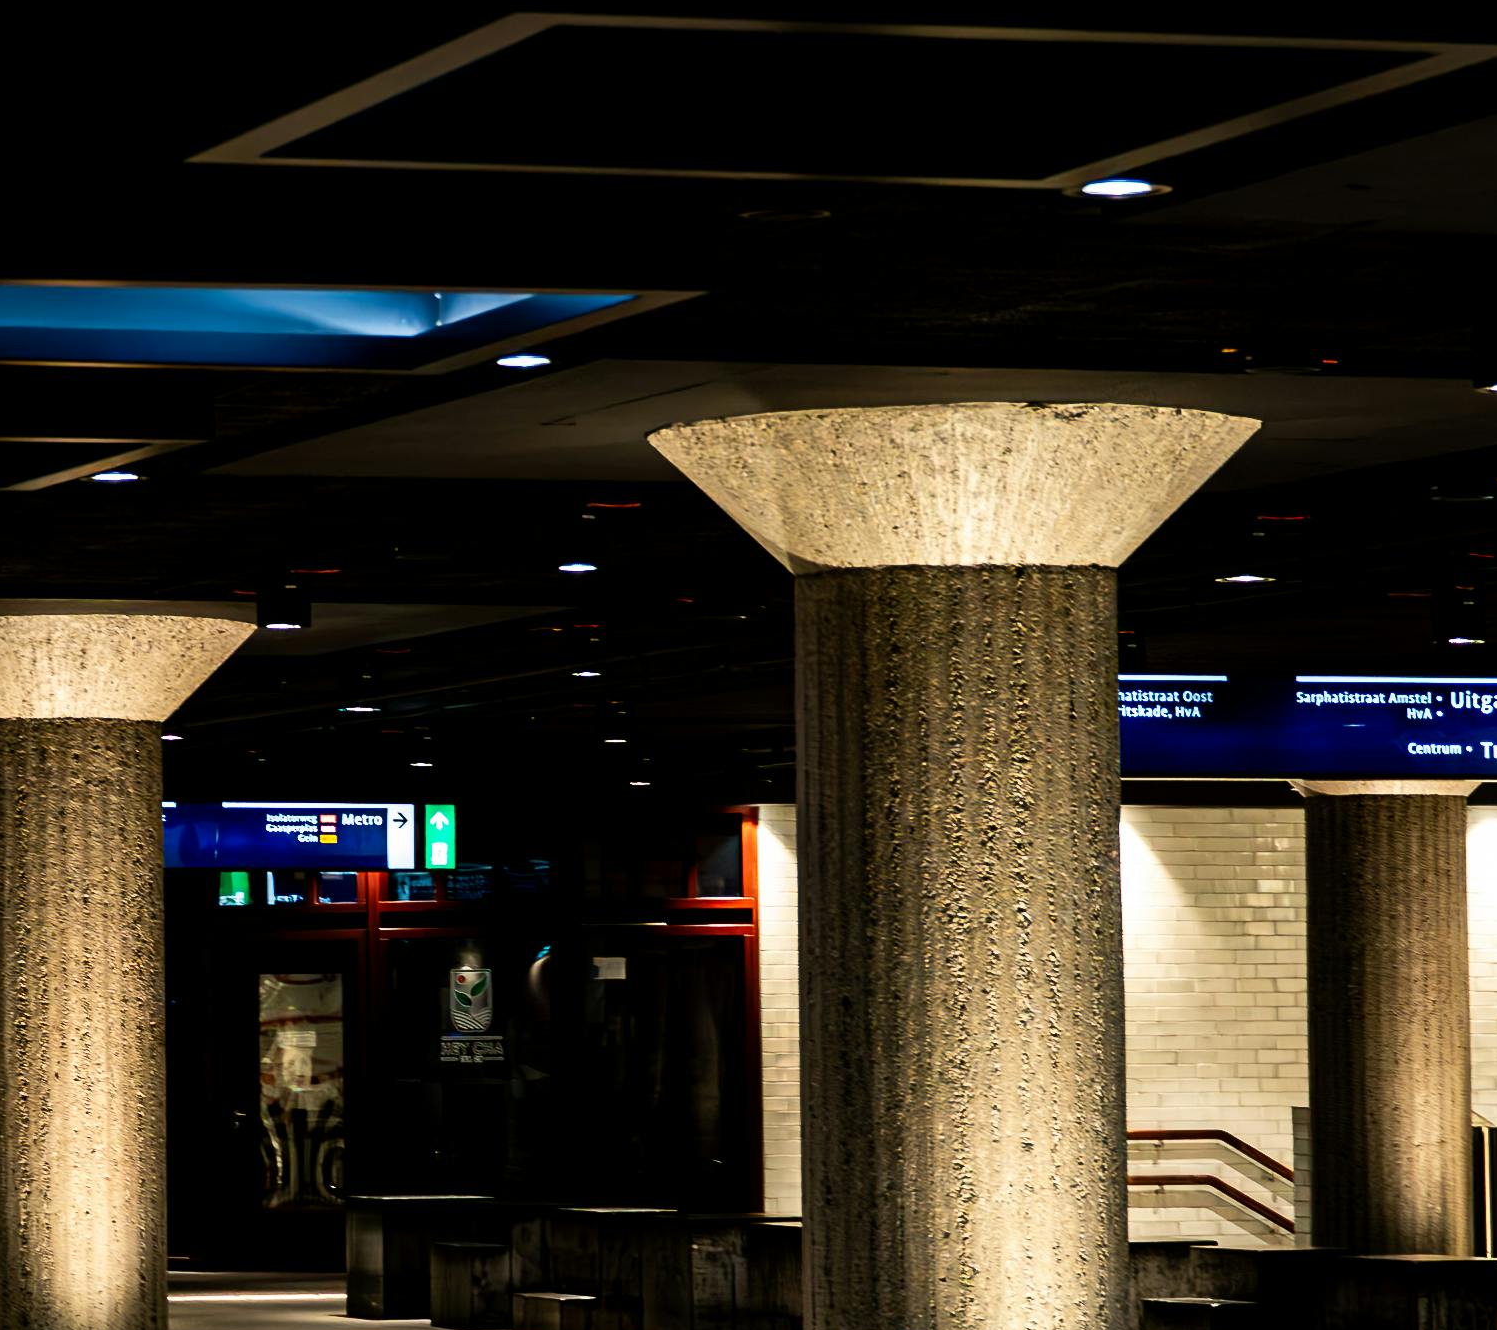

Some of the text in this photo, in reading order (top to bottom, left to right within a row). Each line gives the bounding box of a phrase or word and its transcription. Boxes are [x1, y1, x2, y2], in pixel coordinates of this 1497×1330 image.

[1182, 690, 1213, 703] Oost
[1295, 690, 1386, 707] Sarphatistraat
[1387, 691, 1432, 705] Amstel
[1174, 705, 1201, 718] HvA
[1406, 707, 1433, 720] HvA
[1407, 742, 1462, 755] Centrum
[341, 813, 383, 826] Metro
